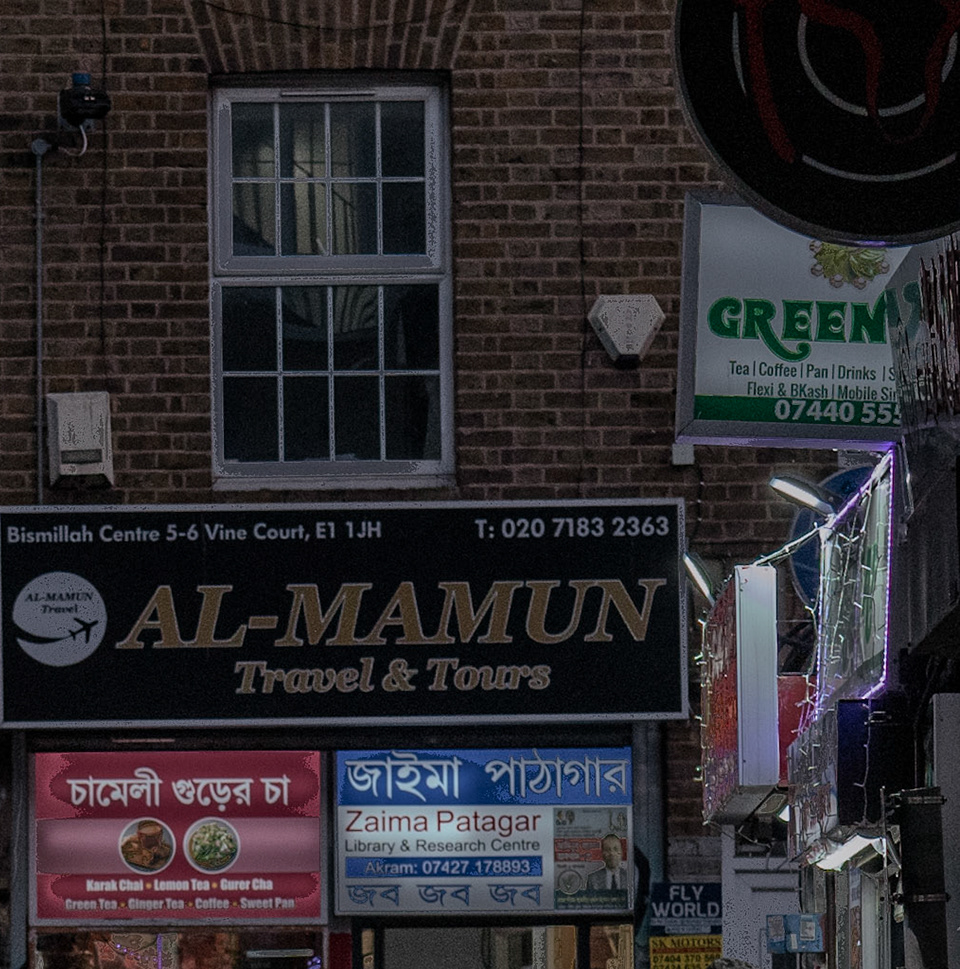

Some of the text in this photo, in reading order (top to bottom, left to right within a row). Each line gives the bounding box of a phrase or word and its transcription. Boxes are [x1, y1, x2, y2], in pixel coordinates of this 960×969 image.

[730, 361, 749, 375] Tea
[759, 362, 797, 378] Coffee
[807, 364, 828, 378] Pan
[838, 365, 876, 381] Drinks
[747, 382, 774, 396] Flexi
[778, 384, 790, 397] &
[790, 384, 828, 398] BKash
[838, 386, 878, 401] Mobile
[774, 399, 855, 423] 07440
[7, 516, 670, 543] Bismillah Centre 5-6 Vine Court, E1 1JH T: 020 7183 2363
[24, 592, 94, 603] AL-MAMUN
[41, 604, 79, 614] Travel
[115, 578, 667, 650] AL-MAMUN
[234, 657, 552, 694] Travel & Tours
[345, 748, 629, 802] জাইমা পাঠাগার
[66, 766, 291, 812] চামেলী গুড়ের চা
[345, 810, 428, 833] Zaima
[437, 810, 541, 837] Patagar
[345, 838, 396, 855] Library
[400, 839, 411, 852] &
[416, 838, 486, 852] Research
[490, 838, 540, 852] Centre
[365, 859, 530, 876] Akram: 07427 178893
[86, 879, 117, 892] Karak
[119, 878, 143, 892] Chai
[153, 878, 189, 892] Lemon
[190, 878, 210, 891] Tea
[252, 878, 273, 891] Cha
[669, 885, 704, 901] FLY
[65, 897, 295, 912] Green Tea Ginger Tea Coffee Sweet Pan
[651, 902, 720, 918] WORLD
[652, 938, 721, 949] SK MOTORS
